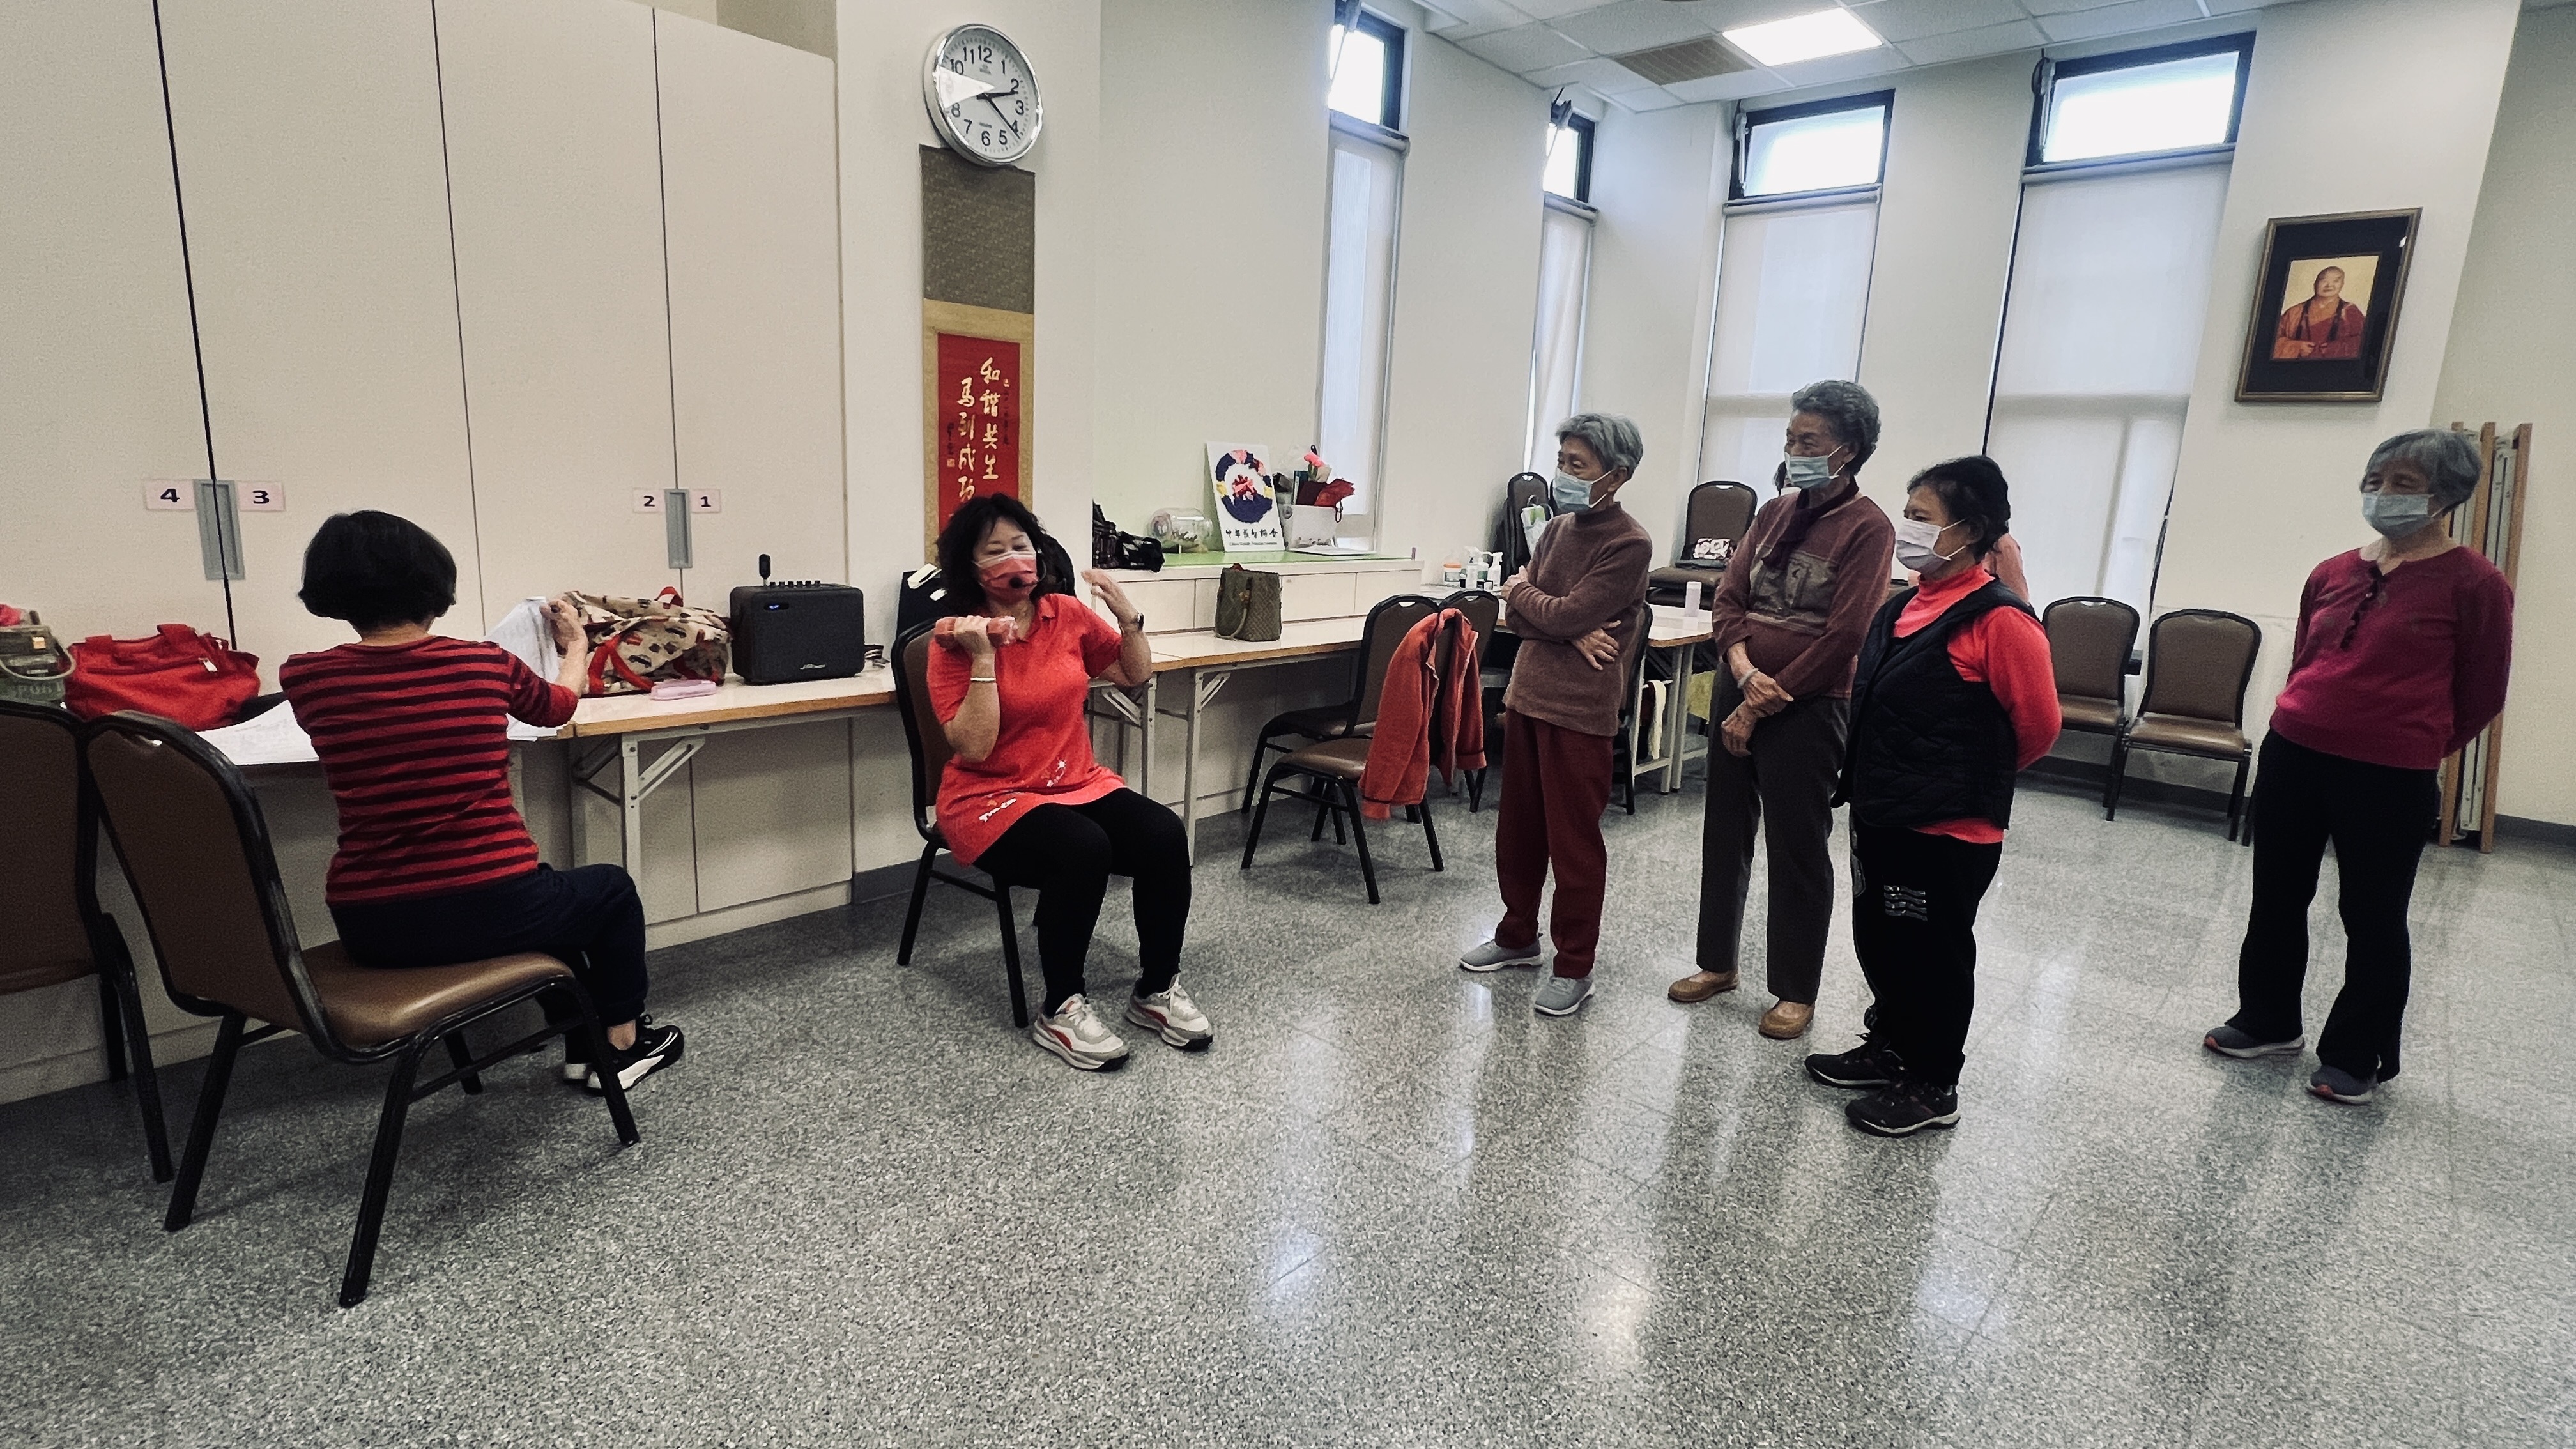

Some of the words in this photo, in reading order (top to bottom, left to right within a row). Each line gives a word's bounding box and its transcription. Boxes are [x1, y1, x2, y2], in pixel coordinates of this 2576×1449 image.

[963, 47, 974, 64] 11
[978, 45, 992, 63] 12
[950, 59, 964, 75] 10
[1001, 60, 1006, 74] 1
[1011, 78, 1020, 94] 2
[951, 102, 961, 118] 8
[1015, 100, 1025, 115] 3
[963, 119, 972, 134] 7
[1011, 119, 1019, 134] 4
[981, 130, 990, 146] 6
[999, 129, 1008, 145] 5
[160, 488, 180, 503] 4
[252, 490, 270, 504] 3
[643, 495, 656, 507] 2
[700, 496, 711, 507] 1
